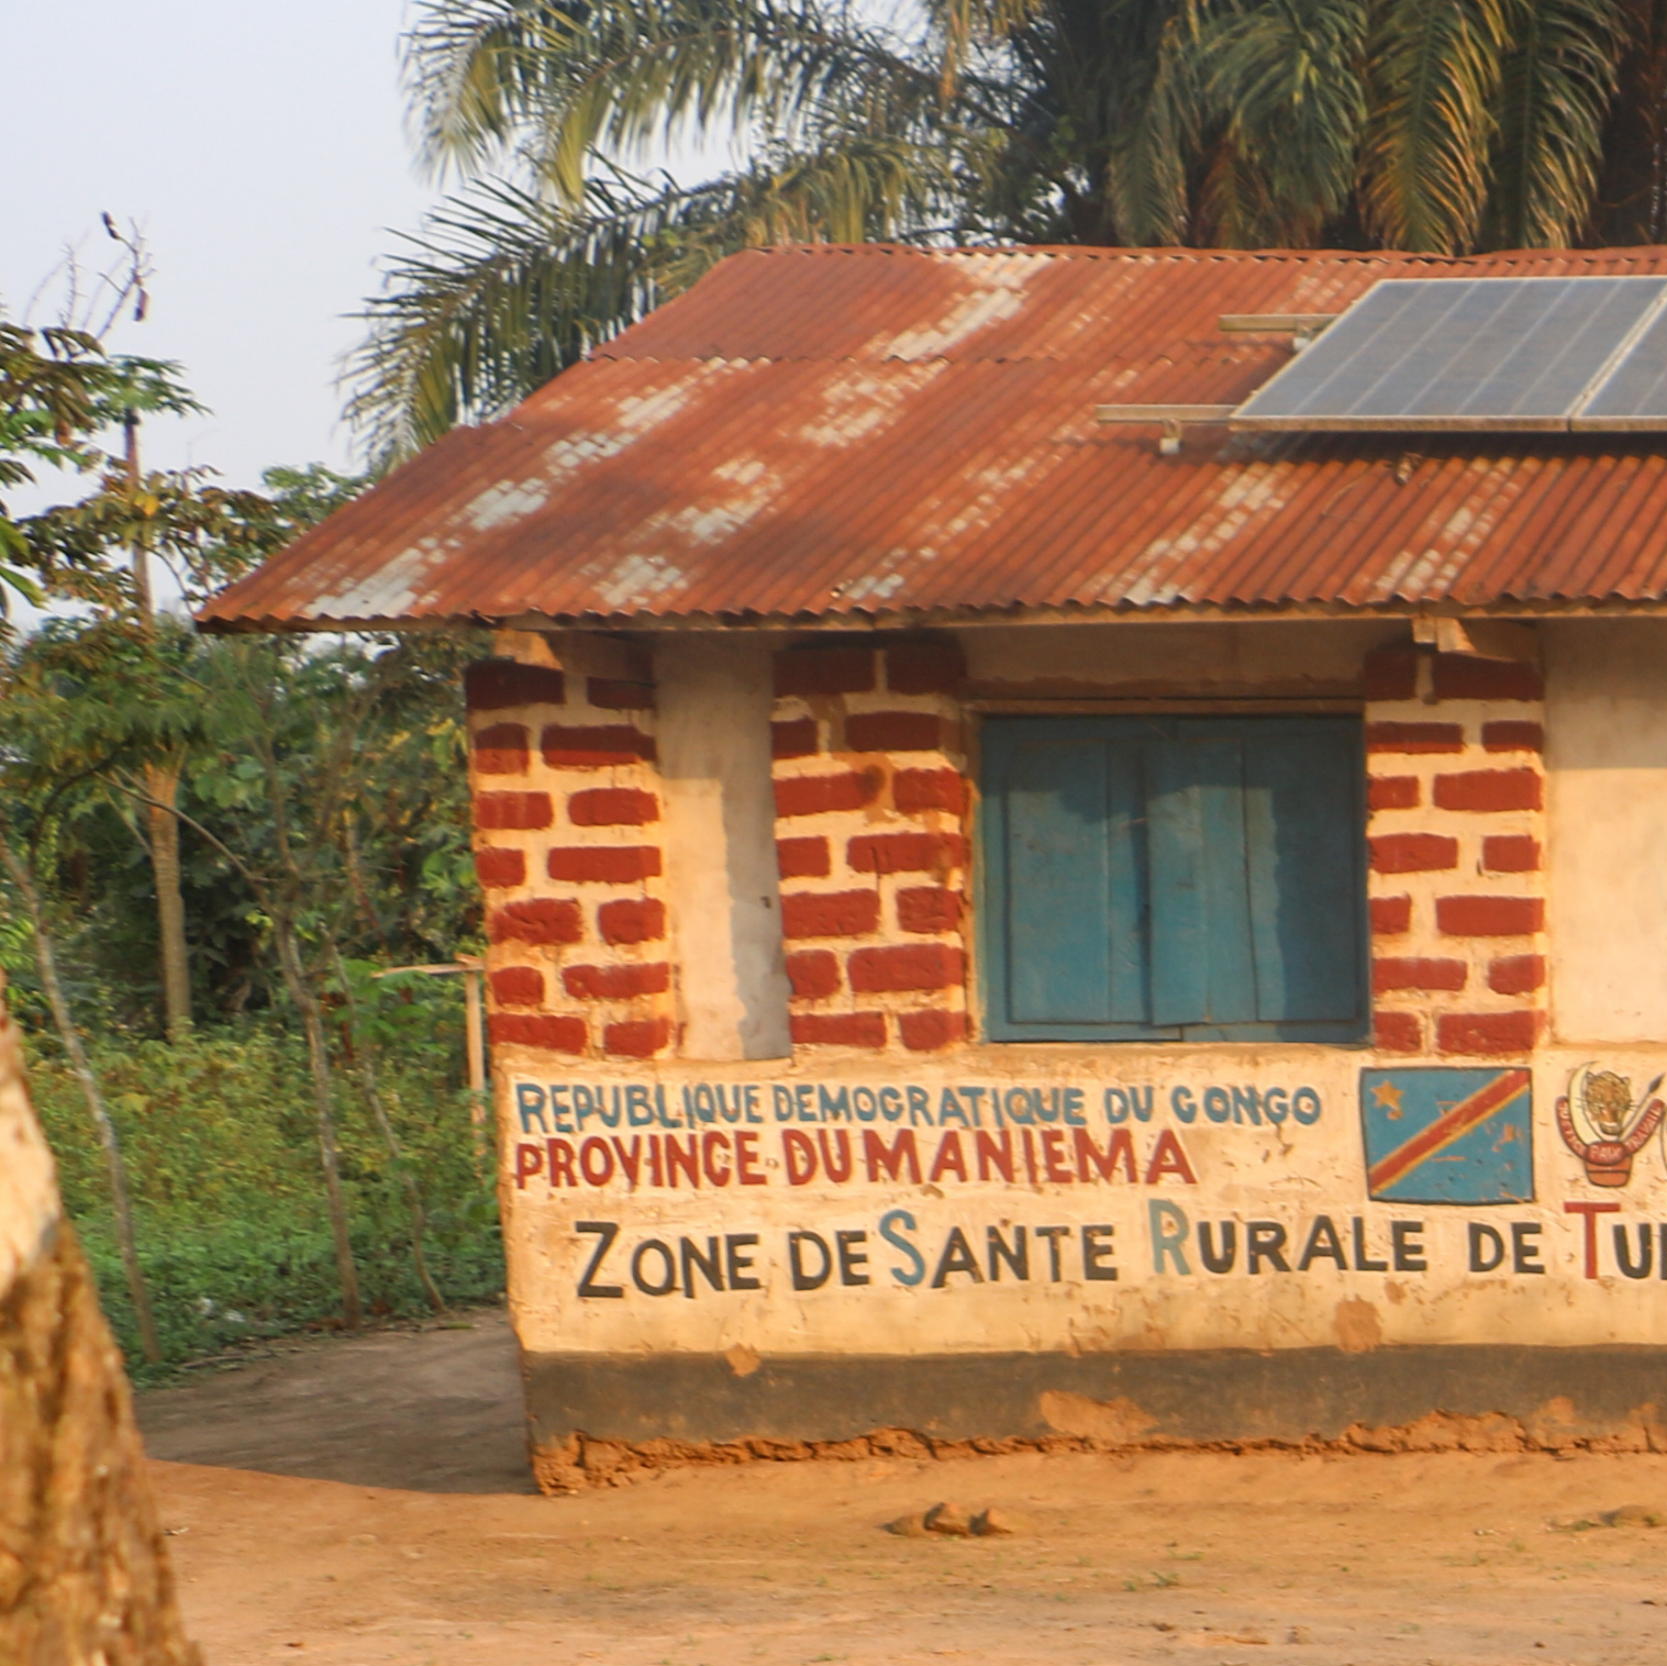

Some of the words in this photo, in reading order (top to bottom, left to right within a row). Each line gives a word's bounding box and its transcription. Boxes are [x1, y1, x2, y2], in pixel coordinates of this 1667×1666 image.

[515, 1082, 764, 1133] REPUBLIQUE
[1104, 1085, 1153, 1124] DU
[779, 1128, 852, 1187] DU
[861, 1126, 1198, 1187] MANIEMA
[575, 1220, 762, 1300] ZONE
[786, 1228, 871, 1293] DE
[877, 1208, 1119, 1288] SANTE
[1147, 1198, 1428, 1276] RURALE
[1468, 1220, 1546, 1275] DE
